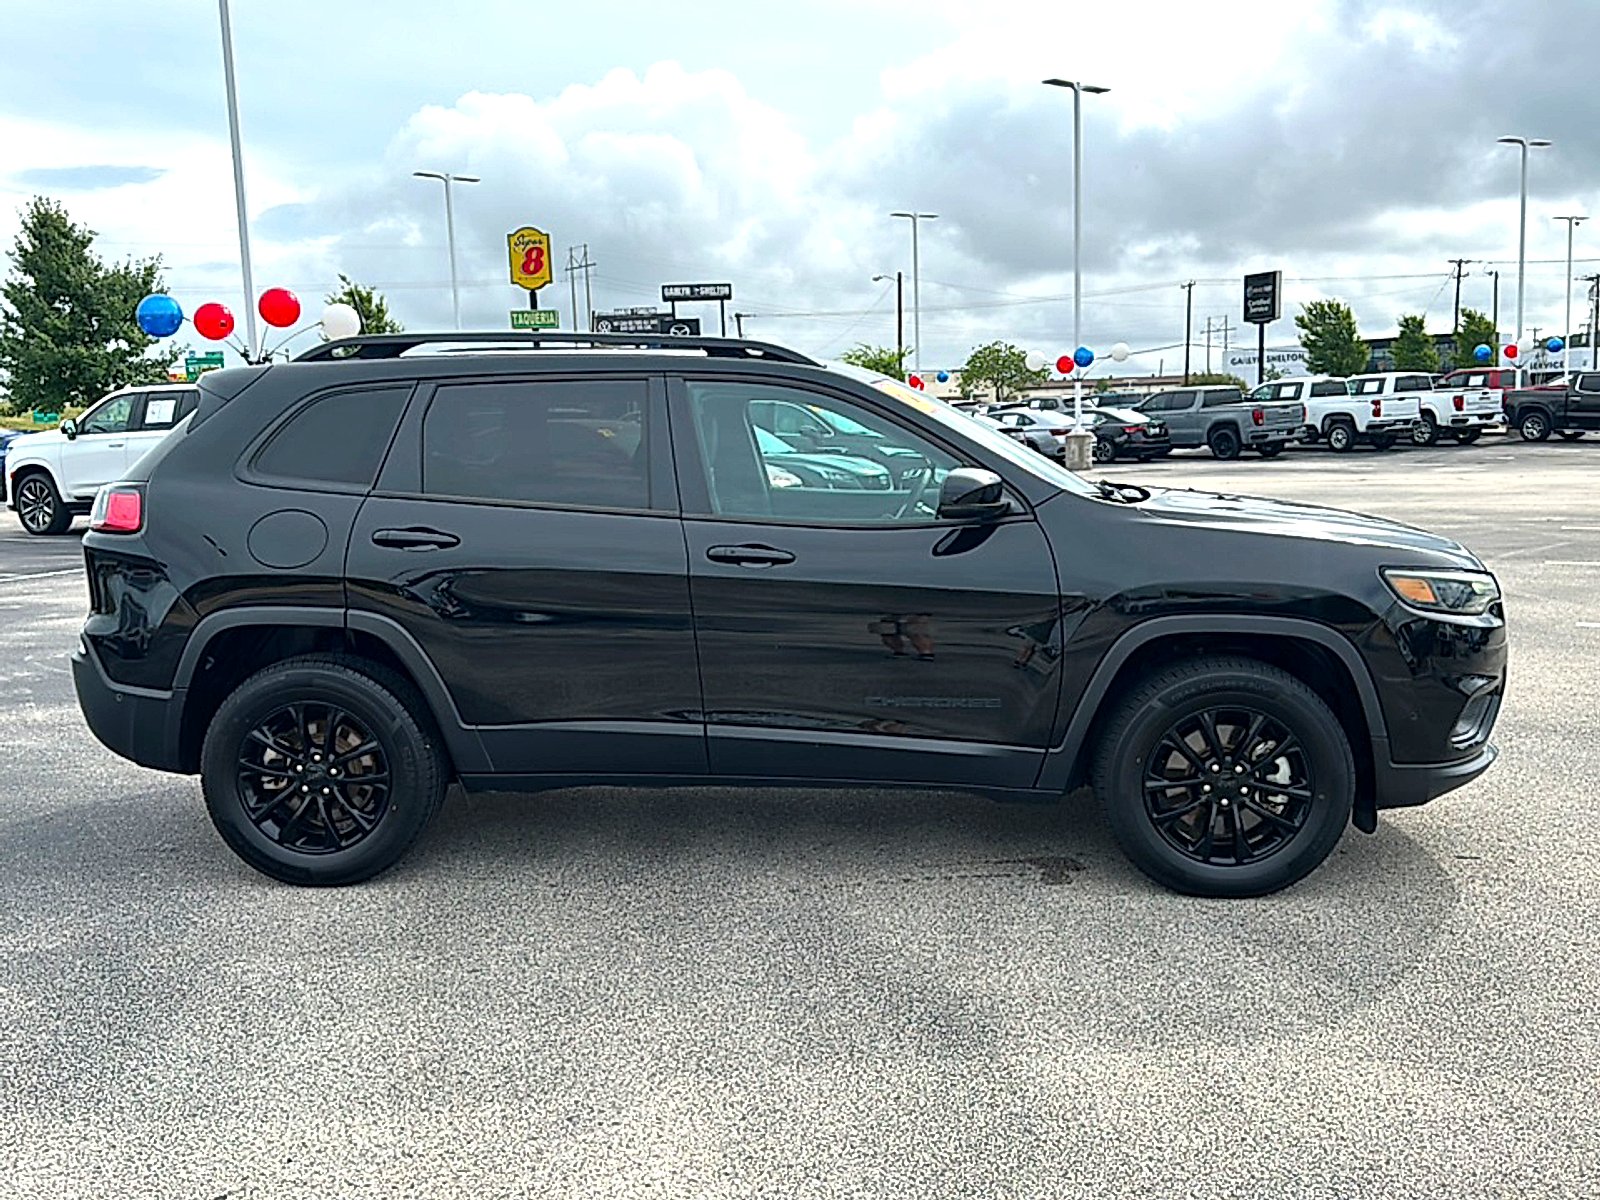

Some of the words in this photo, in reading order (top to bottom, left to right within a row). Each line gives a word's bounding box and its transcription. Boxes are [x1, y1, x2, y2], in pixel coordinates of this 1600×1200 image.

[521, 246, 545, 276] 8
[512, 312, 555, 325] TAQUERIA
[864, 697, 1002, 708] CHEROKEE
